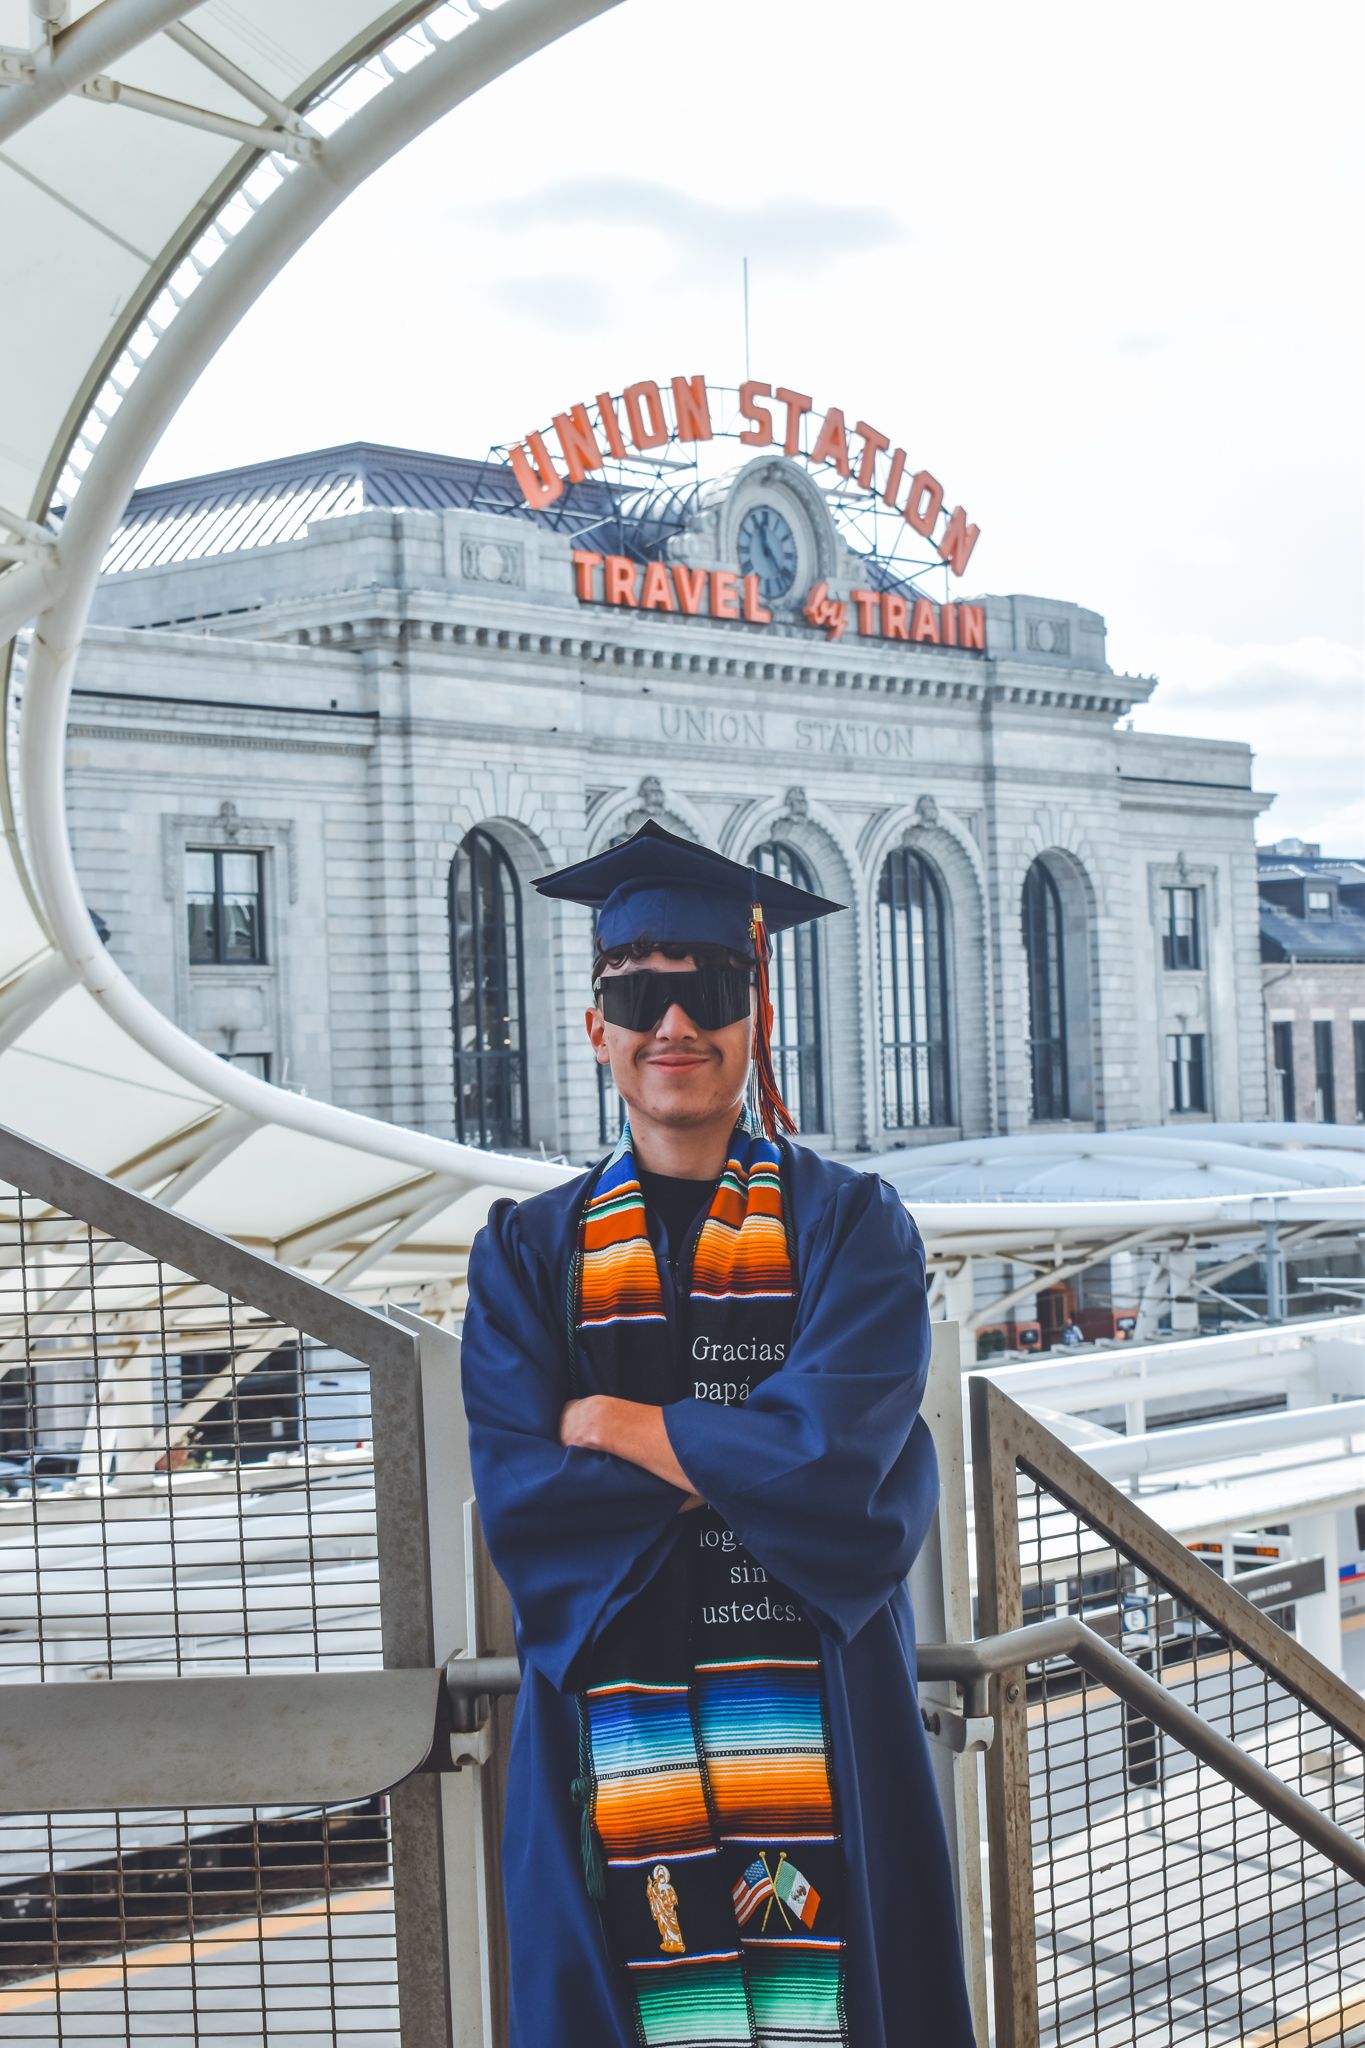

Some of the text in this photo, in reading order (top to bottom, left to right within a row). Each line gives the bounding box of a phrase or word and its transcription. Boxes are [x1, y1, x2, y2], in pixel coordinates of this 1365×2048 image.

[509, 375, 981, 577] UNION STATION
[572, 550, 986, 650] TRAVEL by TRAIN
[659, 705, 914, 758] UNION STATION
[691, 1336, 786, 1361] Gracias
[693, 1375, 750, 1407] papá
[730, 1560, 768, 1584] sin
[702, 1596, 802, 1624] ustedes.
